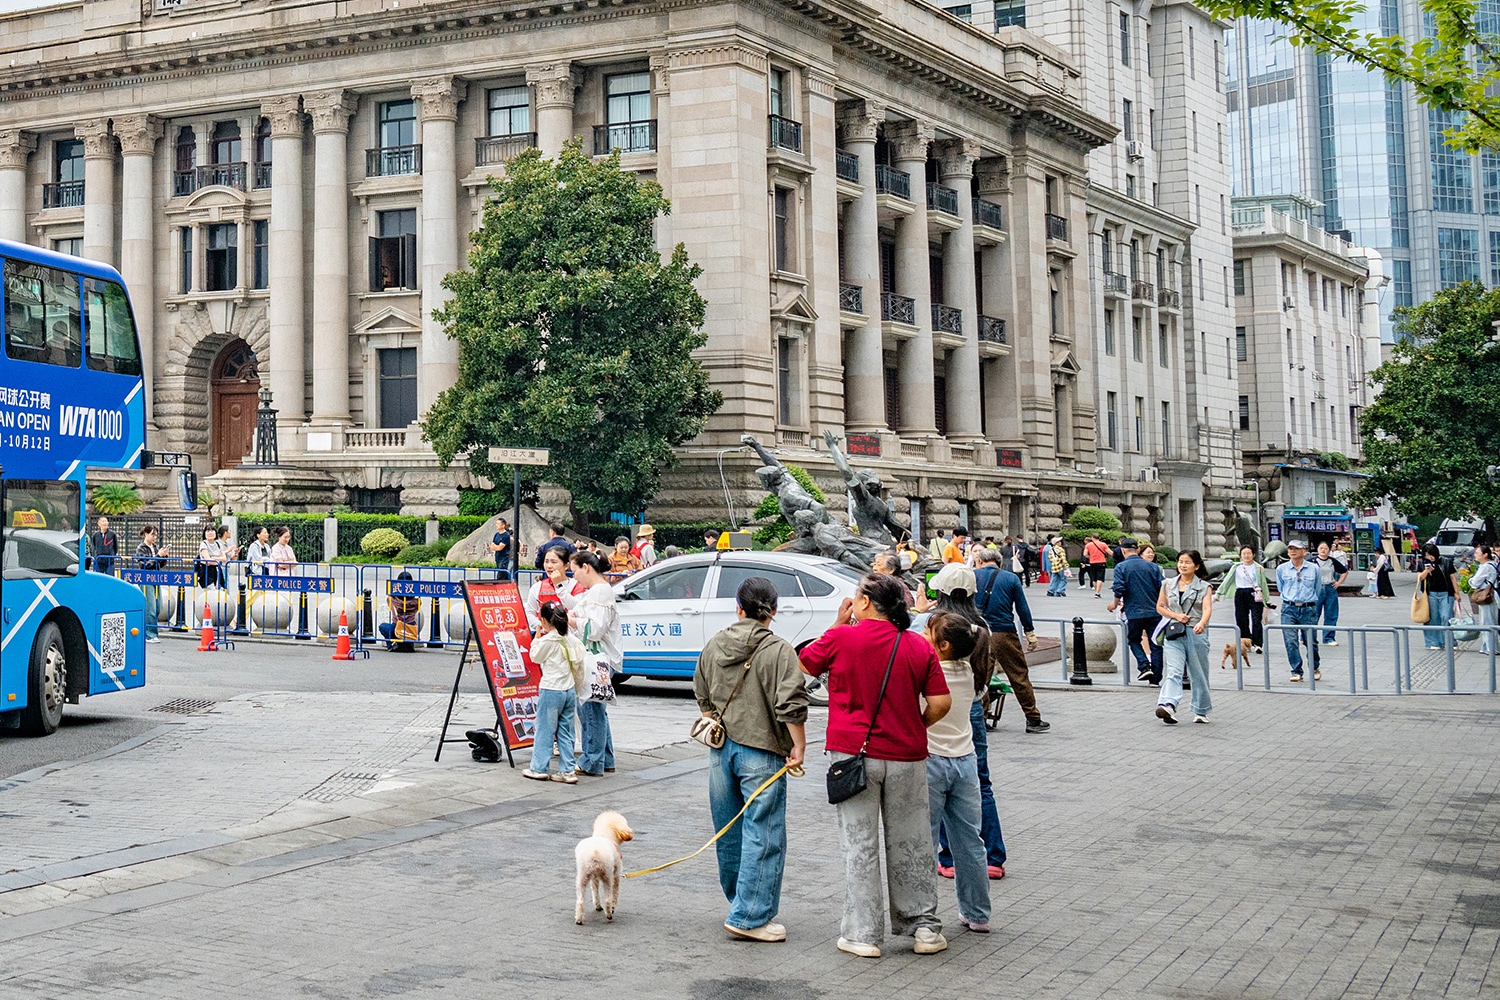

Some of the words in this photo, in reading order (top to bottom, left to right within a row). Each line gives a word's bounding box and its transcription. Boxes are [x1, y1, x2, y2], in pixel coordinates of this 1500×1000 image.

[17, 412, 50, 431] OPEN
[123, 573, 142, 583] 武汉
[145, 574, 168, 583] POLICE
[173, 573, 193, 584] 交警
[254, 578, 273, 589] 武汉
[277, 580, 301, 589] POLICE
[307, 580, 328, 591] 交警
[392, 582, 415, 594] 武汉
[419, 584, 446, 594] POLICE
[453, 584, 463, 596] 交
